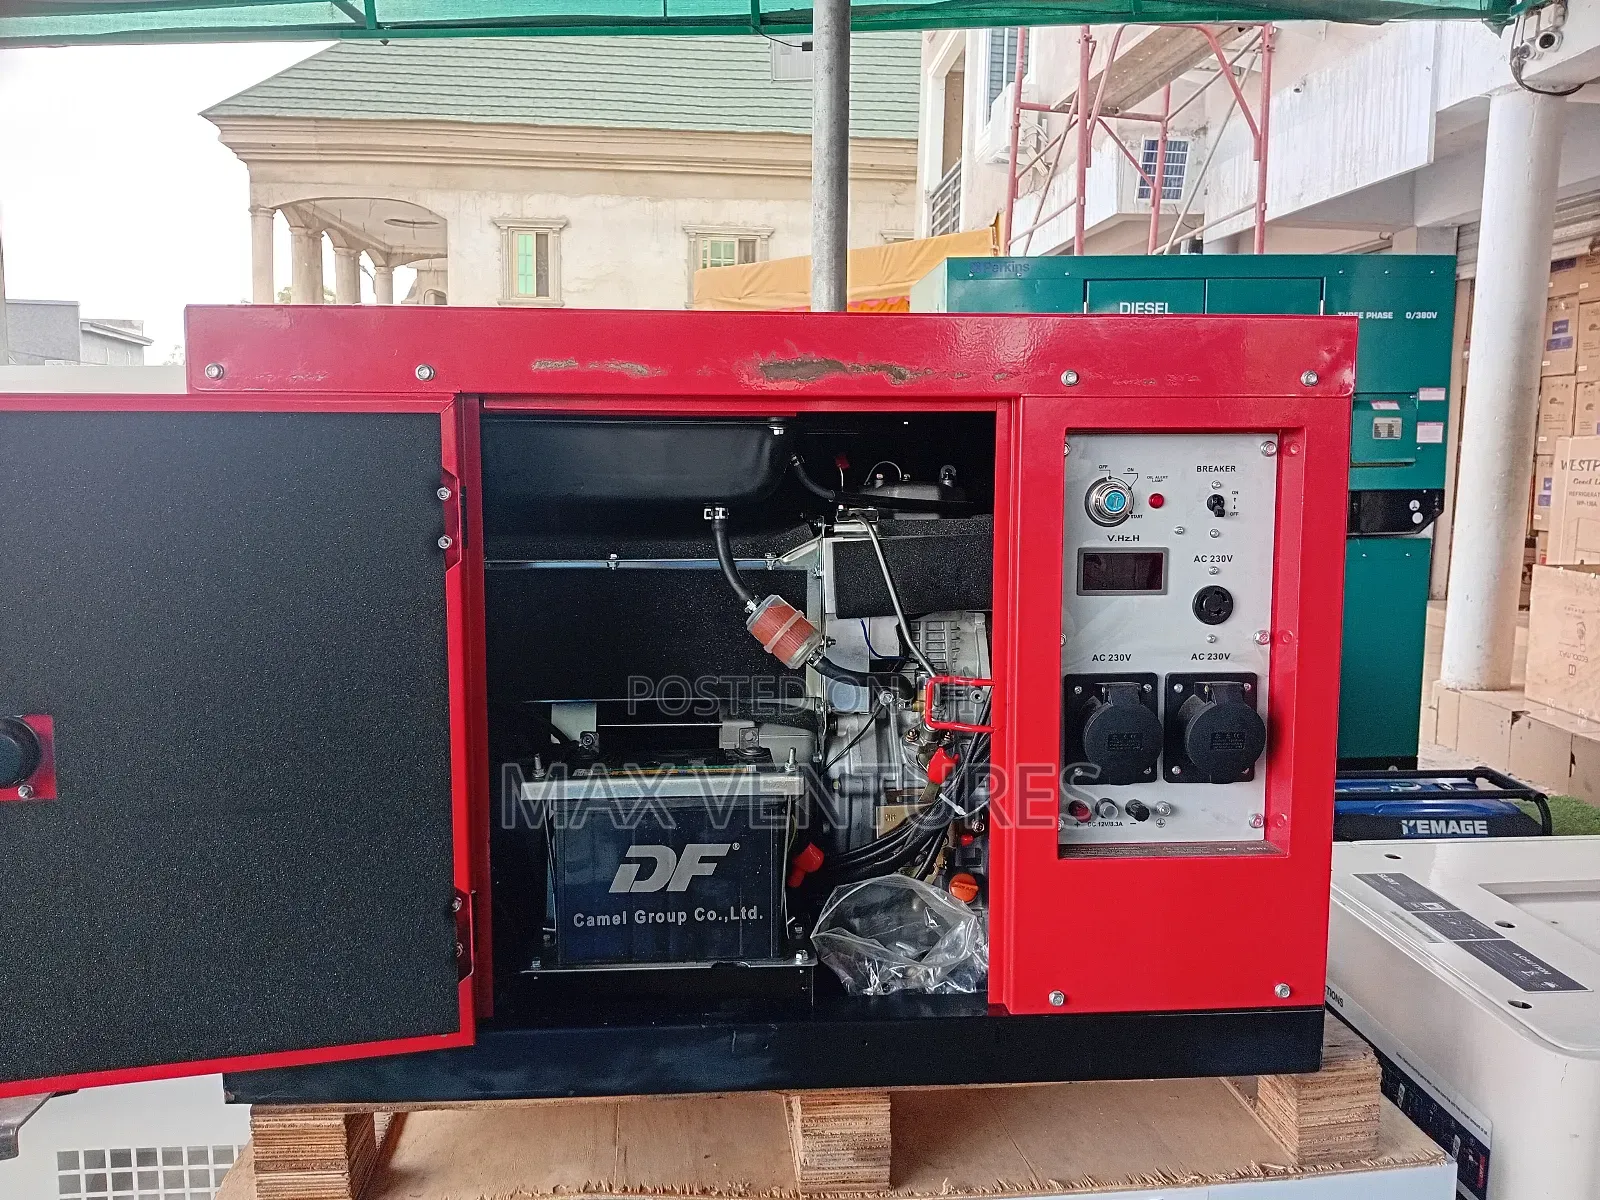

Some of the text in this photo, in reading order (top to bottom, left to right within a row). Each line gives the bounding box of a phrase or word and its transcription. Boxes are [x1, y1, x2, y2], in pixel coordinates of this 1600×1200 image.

[984, 261, 1030, 273] Perkins
[1119, 302, 1174, 314] DIESEL
[1366, 311, 1394, 319] PHASE
[1405, 311, 1438, 319] 0/380V
[1196, 465, 1237, 473] BREAKER
[1193, 555, 1234, 563] AC 230V
[1091, 653, 1132, 662] AC 230V
[1190, 652, 1231, 661] AC 230V
[573, 910, 628, 928] Camel
[634, 908, 688, 926] Group
